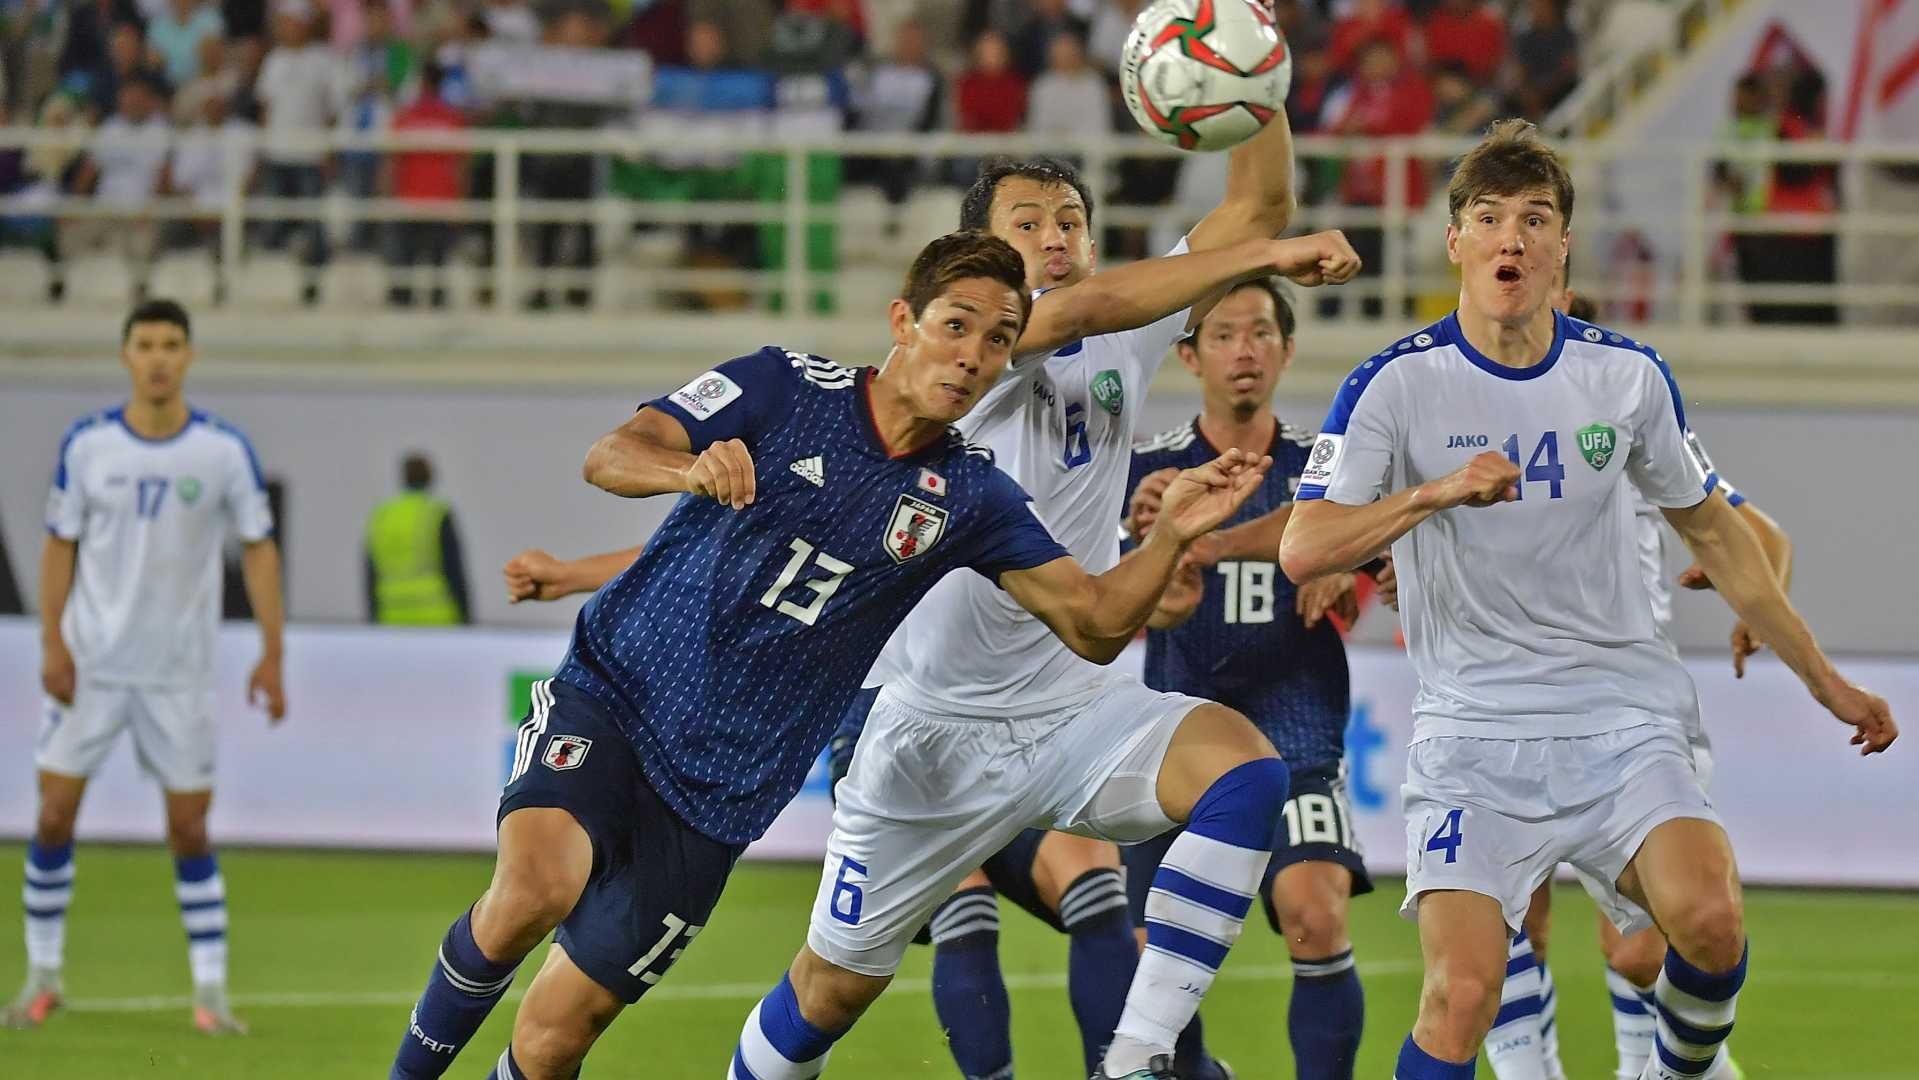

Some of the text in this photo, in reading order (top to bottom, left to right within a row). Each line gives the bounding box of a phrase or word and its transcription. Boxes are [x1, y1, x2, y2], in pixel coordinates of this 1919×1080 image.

[1094, 377, 1120, 401] UFA
[1064, 402, 1092, 470] 6
[1446, 434, 1489, 449] JAKO
[1581, 431, 1611, 451] UFA
[789, 462, 825, 488] adidas
[1502, 430, 1565, 501] 14
[138, 478, 168, 520] 17
[909, 500, 938, 516] JAPAN
[760, 537, 856, 626] 13
[1217, 561, 1276, 623] 18
[1282, 793, 1339, 847] 18
[1418, 809, 1463, 866] 4
[830, 855, 868, 926] 6
[410, 1001, 456, 1055] APAN
